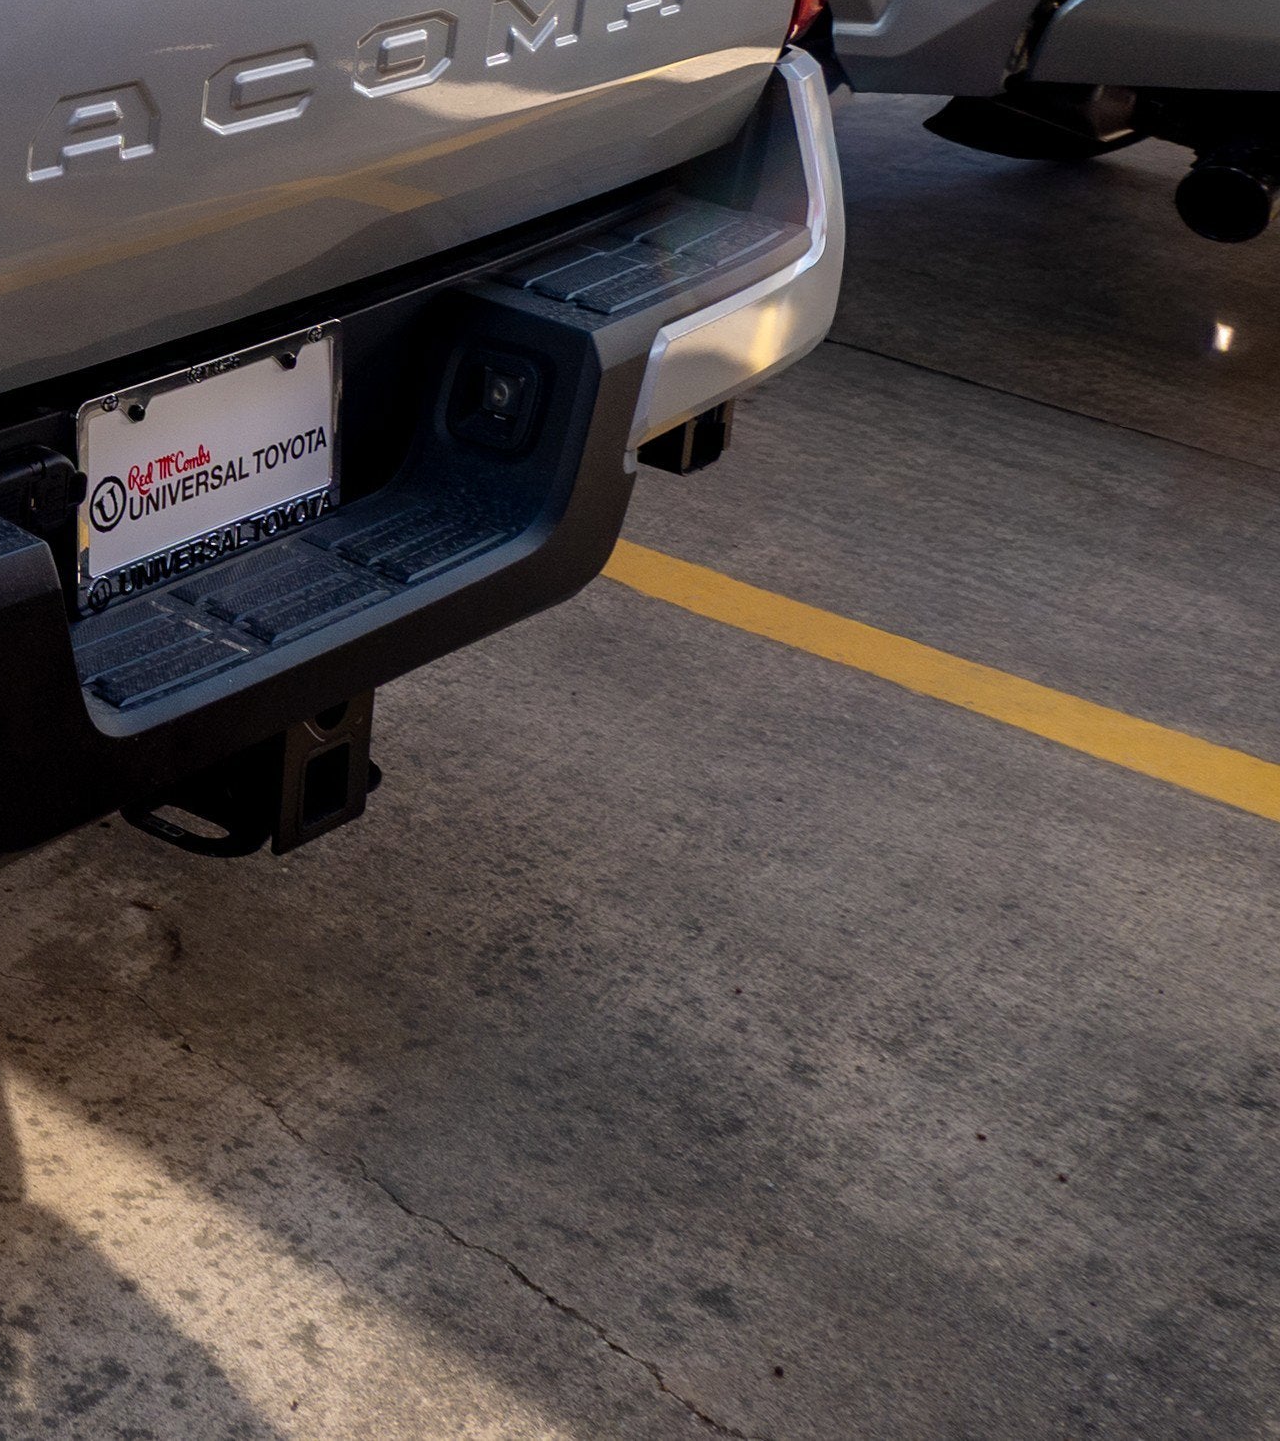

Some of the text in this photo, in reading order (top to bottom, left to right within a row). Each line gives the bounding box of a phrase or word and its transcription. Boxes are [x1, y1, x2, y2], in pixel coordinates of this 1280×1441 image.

[127, 426, 328, 521] UNIVERSAL TOYOTA
[128, 462, 154, 496] Red
[119, 490, 333, 596] UNIVERSAL TOYOTA
